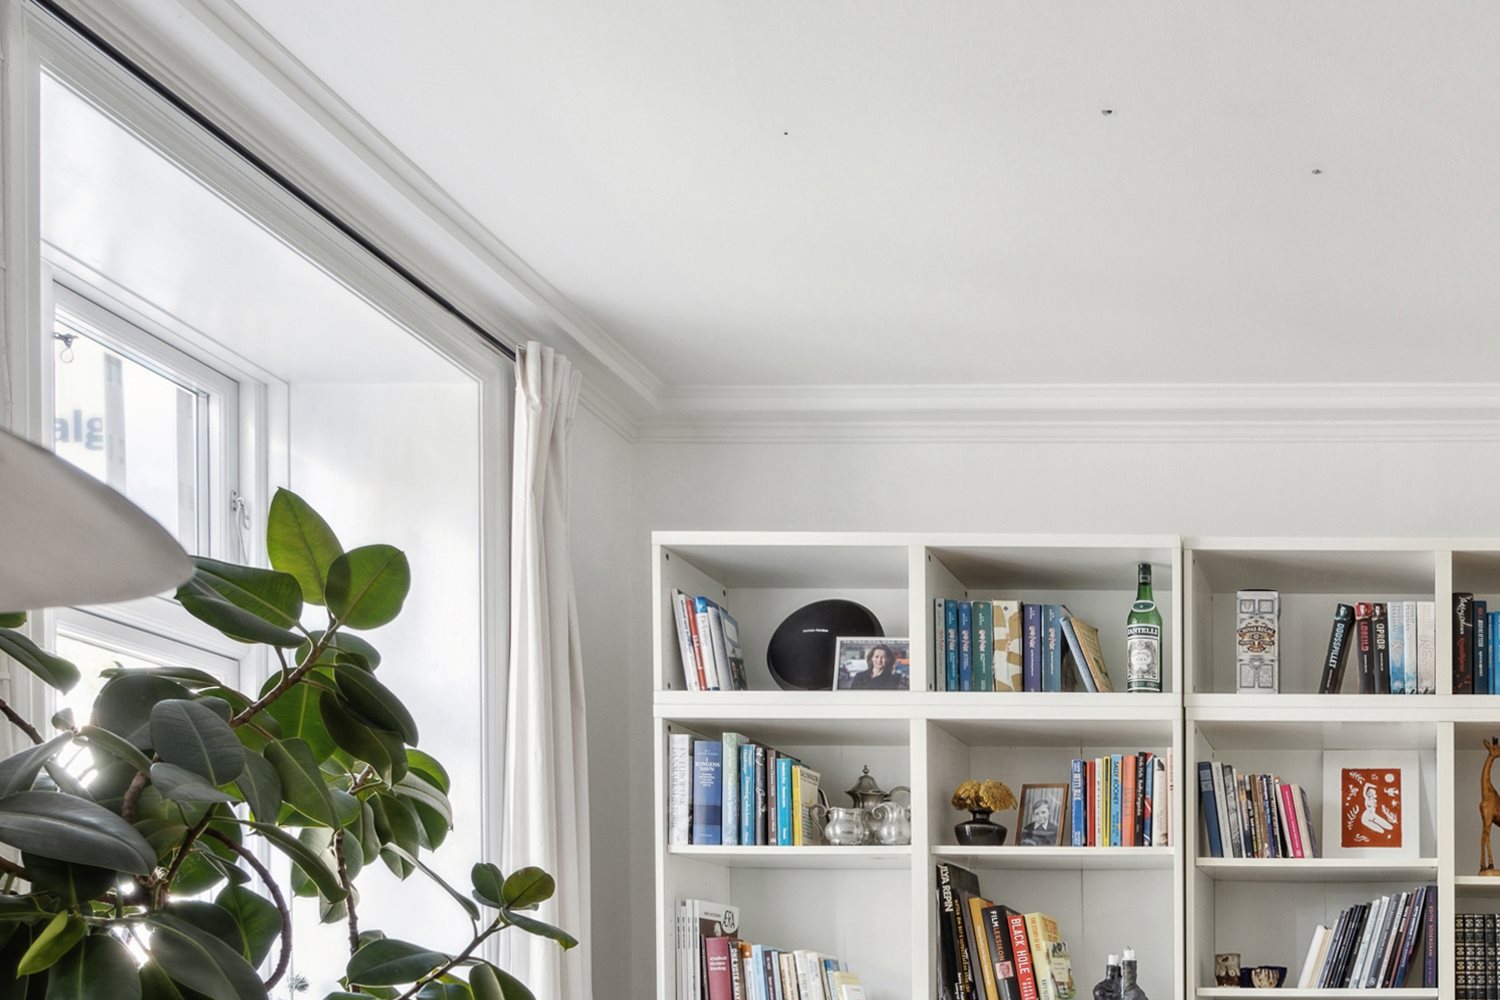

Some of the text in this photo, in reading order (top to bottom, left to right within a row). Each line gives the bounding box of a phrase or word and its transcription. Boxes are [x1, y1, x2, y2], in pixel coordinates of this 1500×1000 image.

[942, 885, 954, 912] REPIN
[1010, 918, 1030, 975] BLACK HOLE
